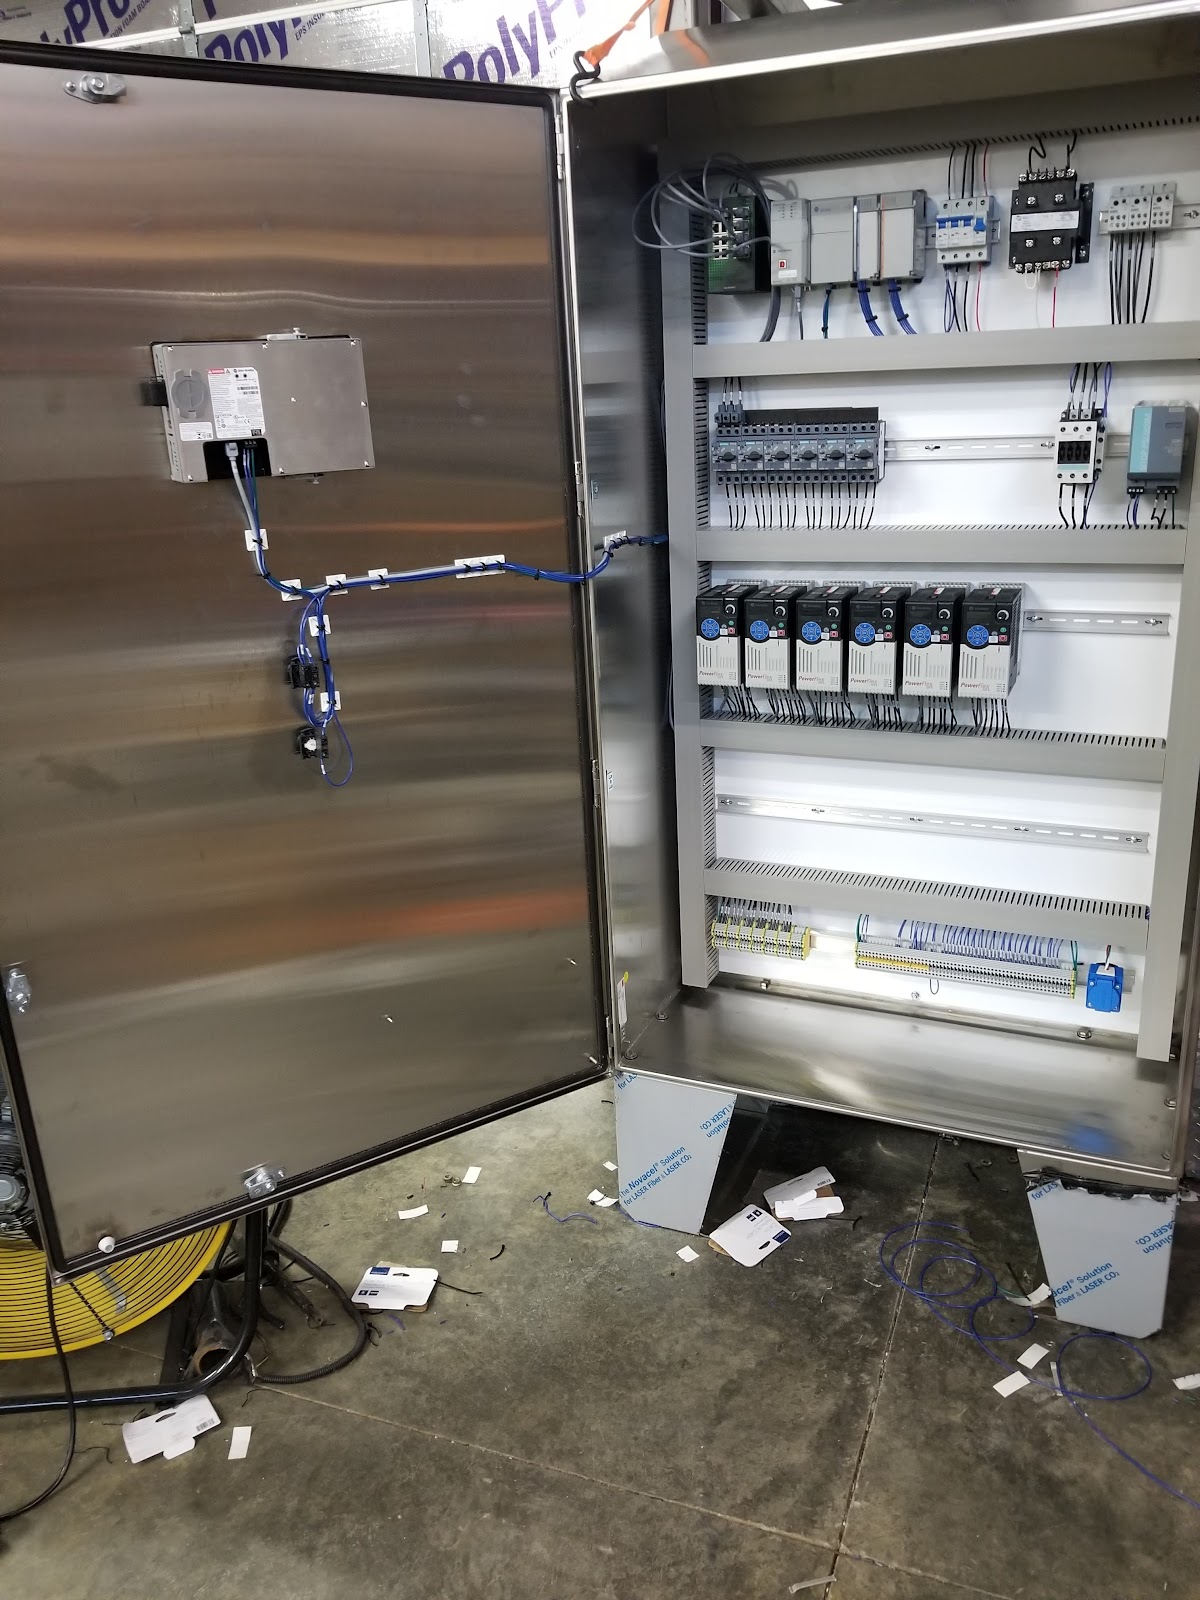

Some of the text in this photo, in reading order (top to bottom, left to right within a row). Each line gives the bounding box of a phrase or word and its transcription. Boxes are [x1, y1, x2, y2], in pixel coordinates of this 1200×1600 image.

[122, 8, 138, 30] FOAM
[294, 12, 325, 41] EPS INSU
[204, 16, 302, 62] Poly
[710, 1107, 730, 1123] LASER
[660, 1146, 686, 1166] Solution
[623, 1197, 633, 1207] for
[631, 1185, 649, 1201] LASER
[647, 1176, 661, 1189] Fiber
[663, 1160, 682, 1177] LASER
[1031, 1190, 1043, 1200] for
[1142, 1234, 1174, 1254] olution
[1076, 1262, 1113, 1283] Solution
[1056, 1293, 1076, 1307] Fiber
[1080, 1277, 1106, 1294] LASER
